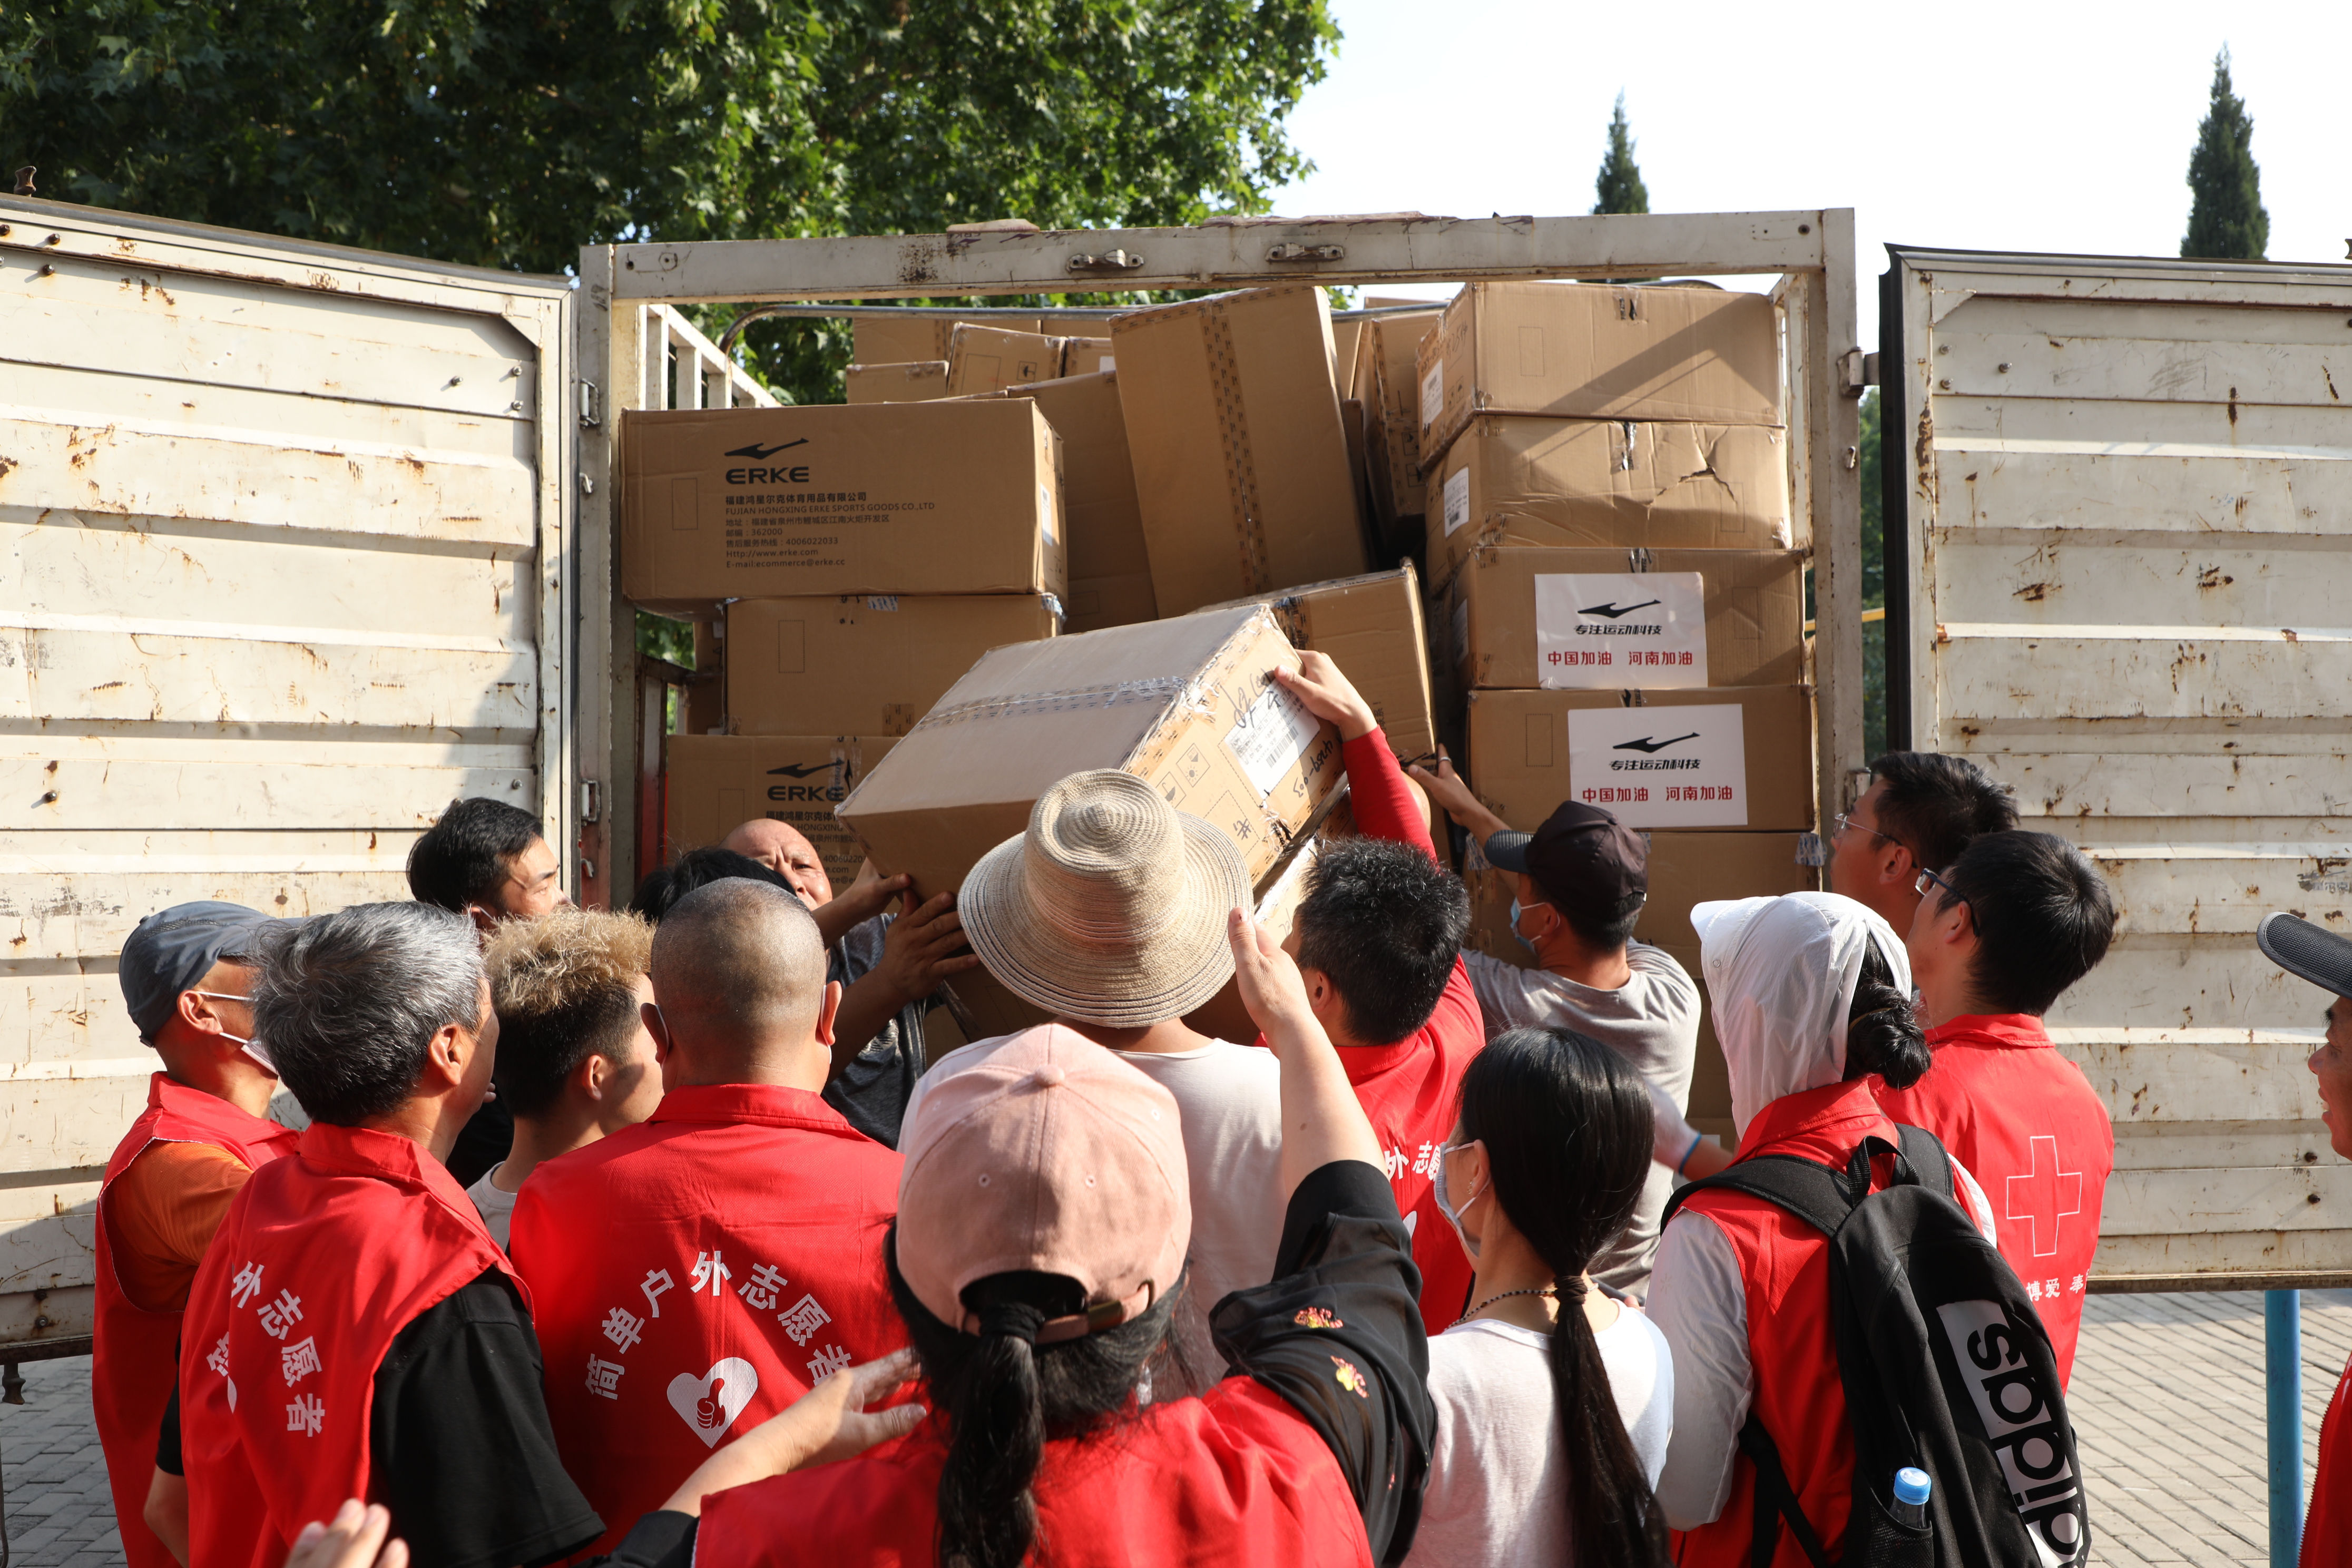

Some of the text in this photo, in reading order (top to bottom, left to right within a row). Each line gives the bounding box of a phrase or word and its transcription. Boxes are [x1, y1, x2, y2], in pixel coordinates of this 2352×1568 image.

[726, 466, 809, 484] ERKE
[726, 492, 867, 505] 福建鸿星尔克体育用品有限公司
[758, 506, 807, 514] HONGXING
[832, 504, 866, 512] SPORTS
[867, 503, 900, 511] GOODS
[901, 502, 935, 511] CO.,LTD
[726, 549, 818, 558] Http://www.erke.com
[1573, 624, 1662, 635] 专注运动科技
[1548, 651, 1693, 666] 中国加油 河南加油
[1609, 759, 1701, 771] 专注运动科技
[767, 786, 844, 802] ERKE
[1582, 786, 1733, 803] 中国加油 河南加油
[2069, 1269, 2090, 1294] 奉
[1967, 1322, 2086, 1568] didas
